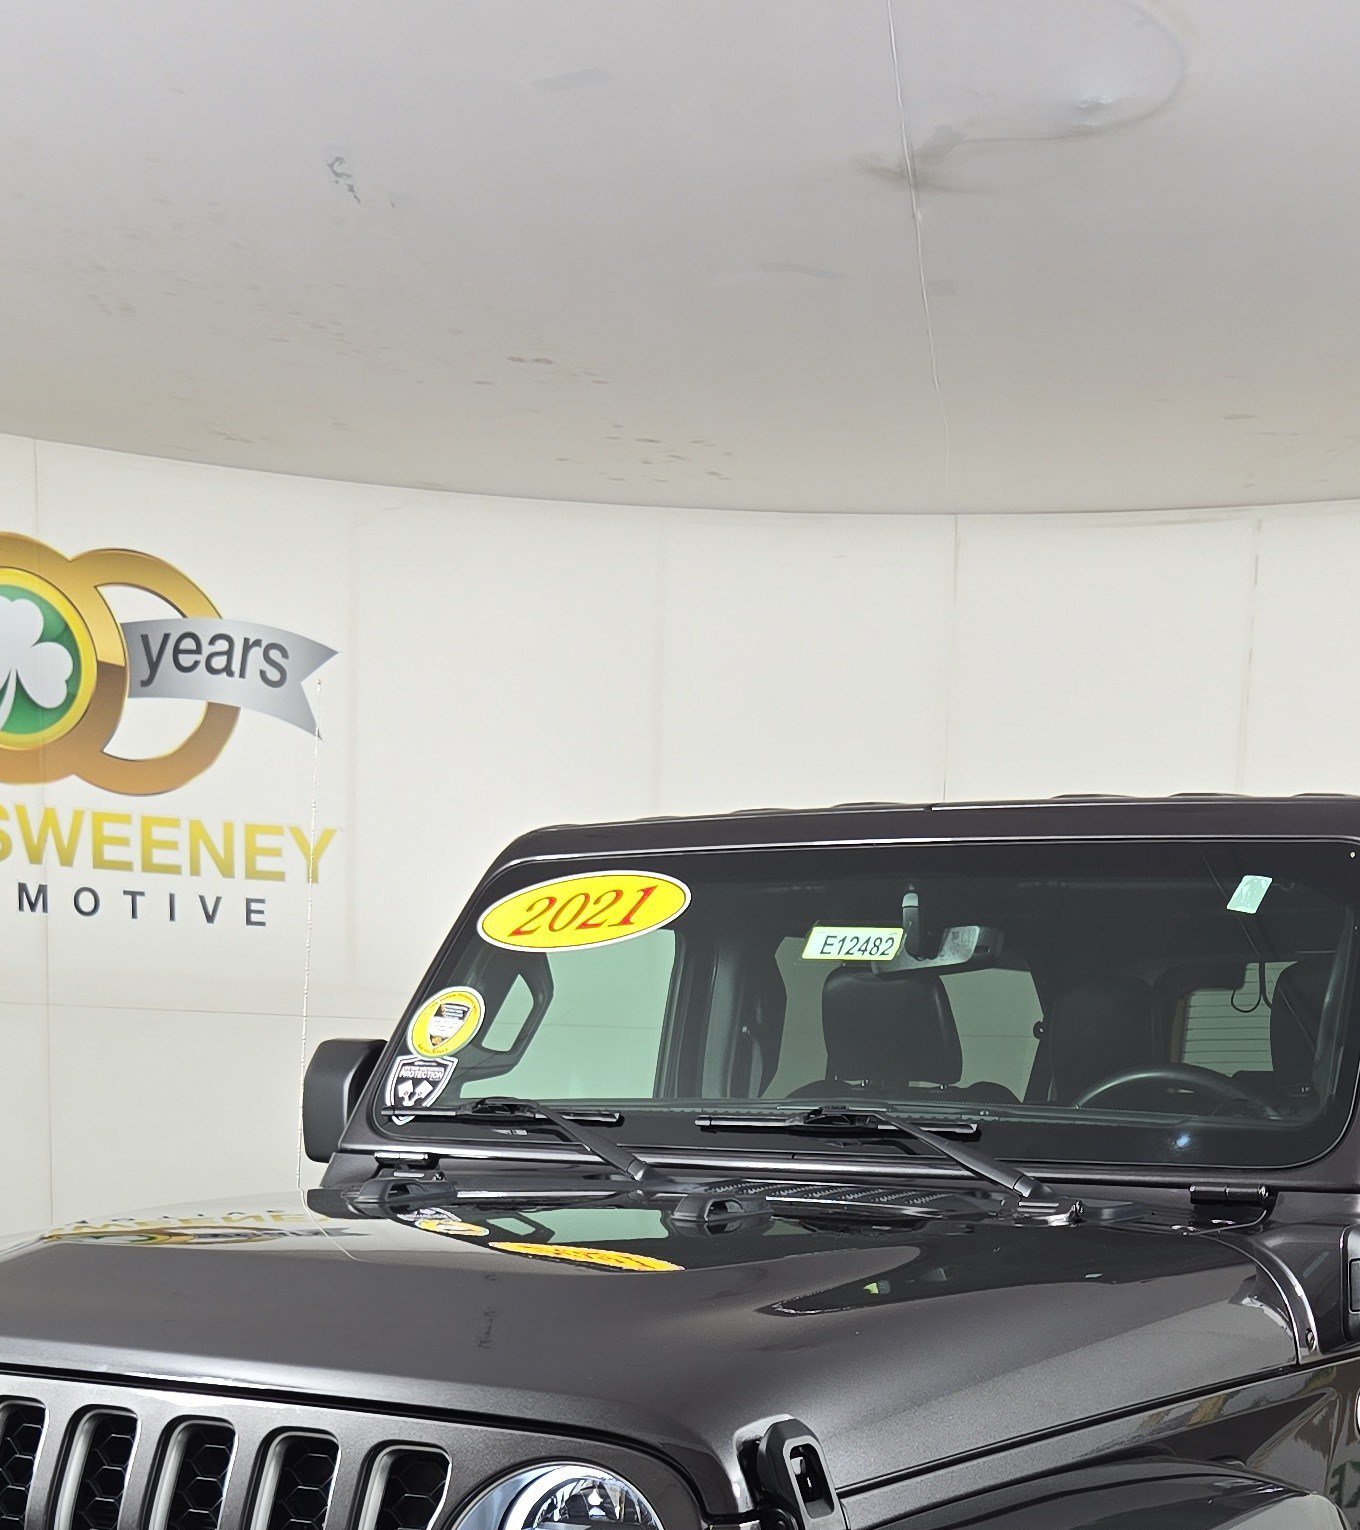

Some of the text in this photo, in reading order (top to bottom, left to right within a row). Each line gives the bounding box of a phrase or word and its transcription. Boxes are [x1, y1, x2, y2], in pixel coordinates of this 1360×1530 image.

[140, 632, 290, 688] years
[508, 885, 658, 937] 2021
[820, 935, 894, 955] E12482
